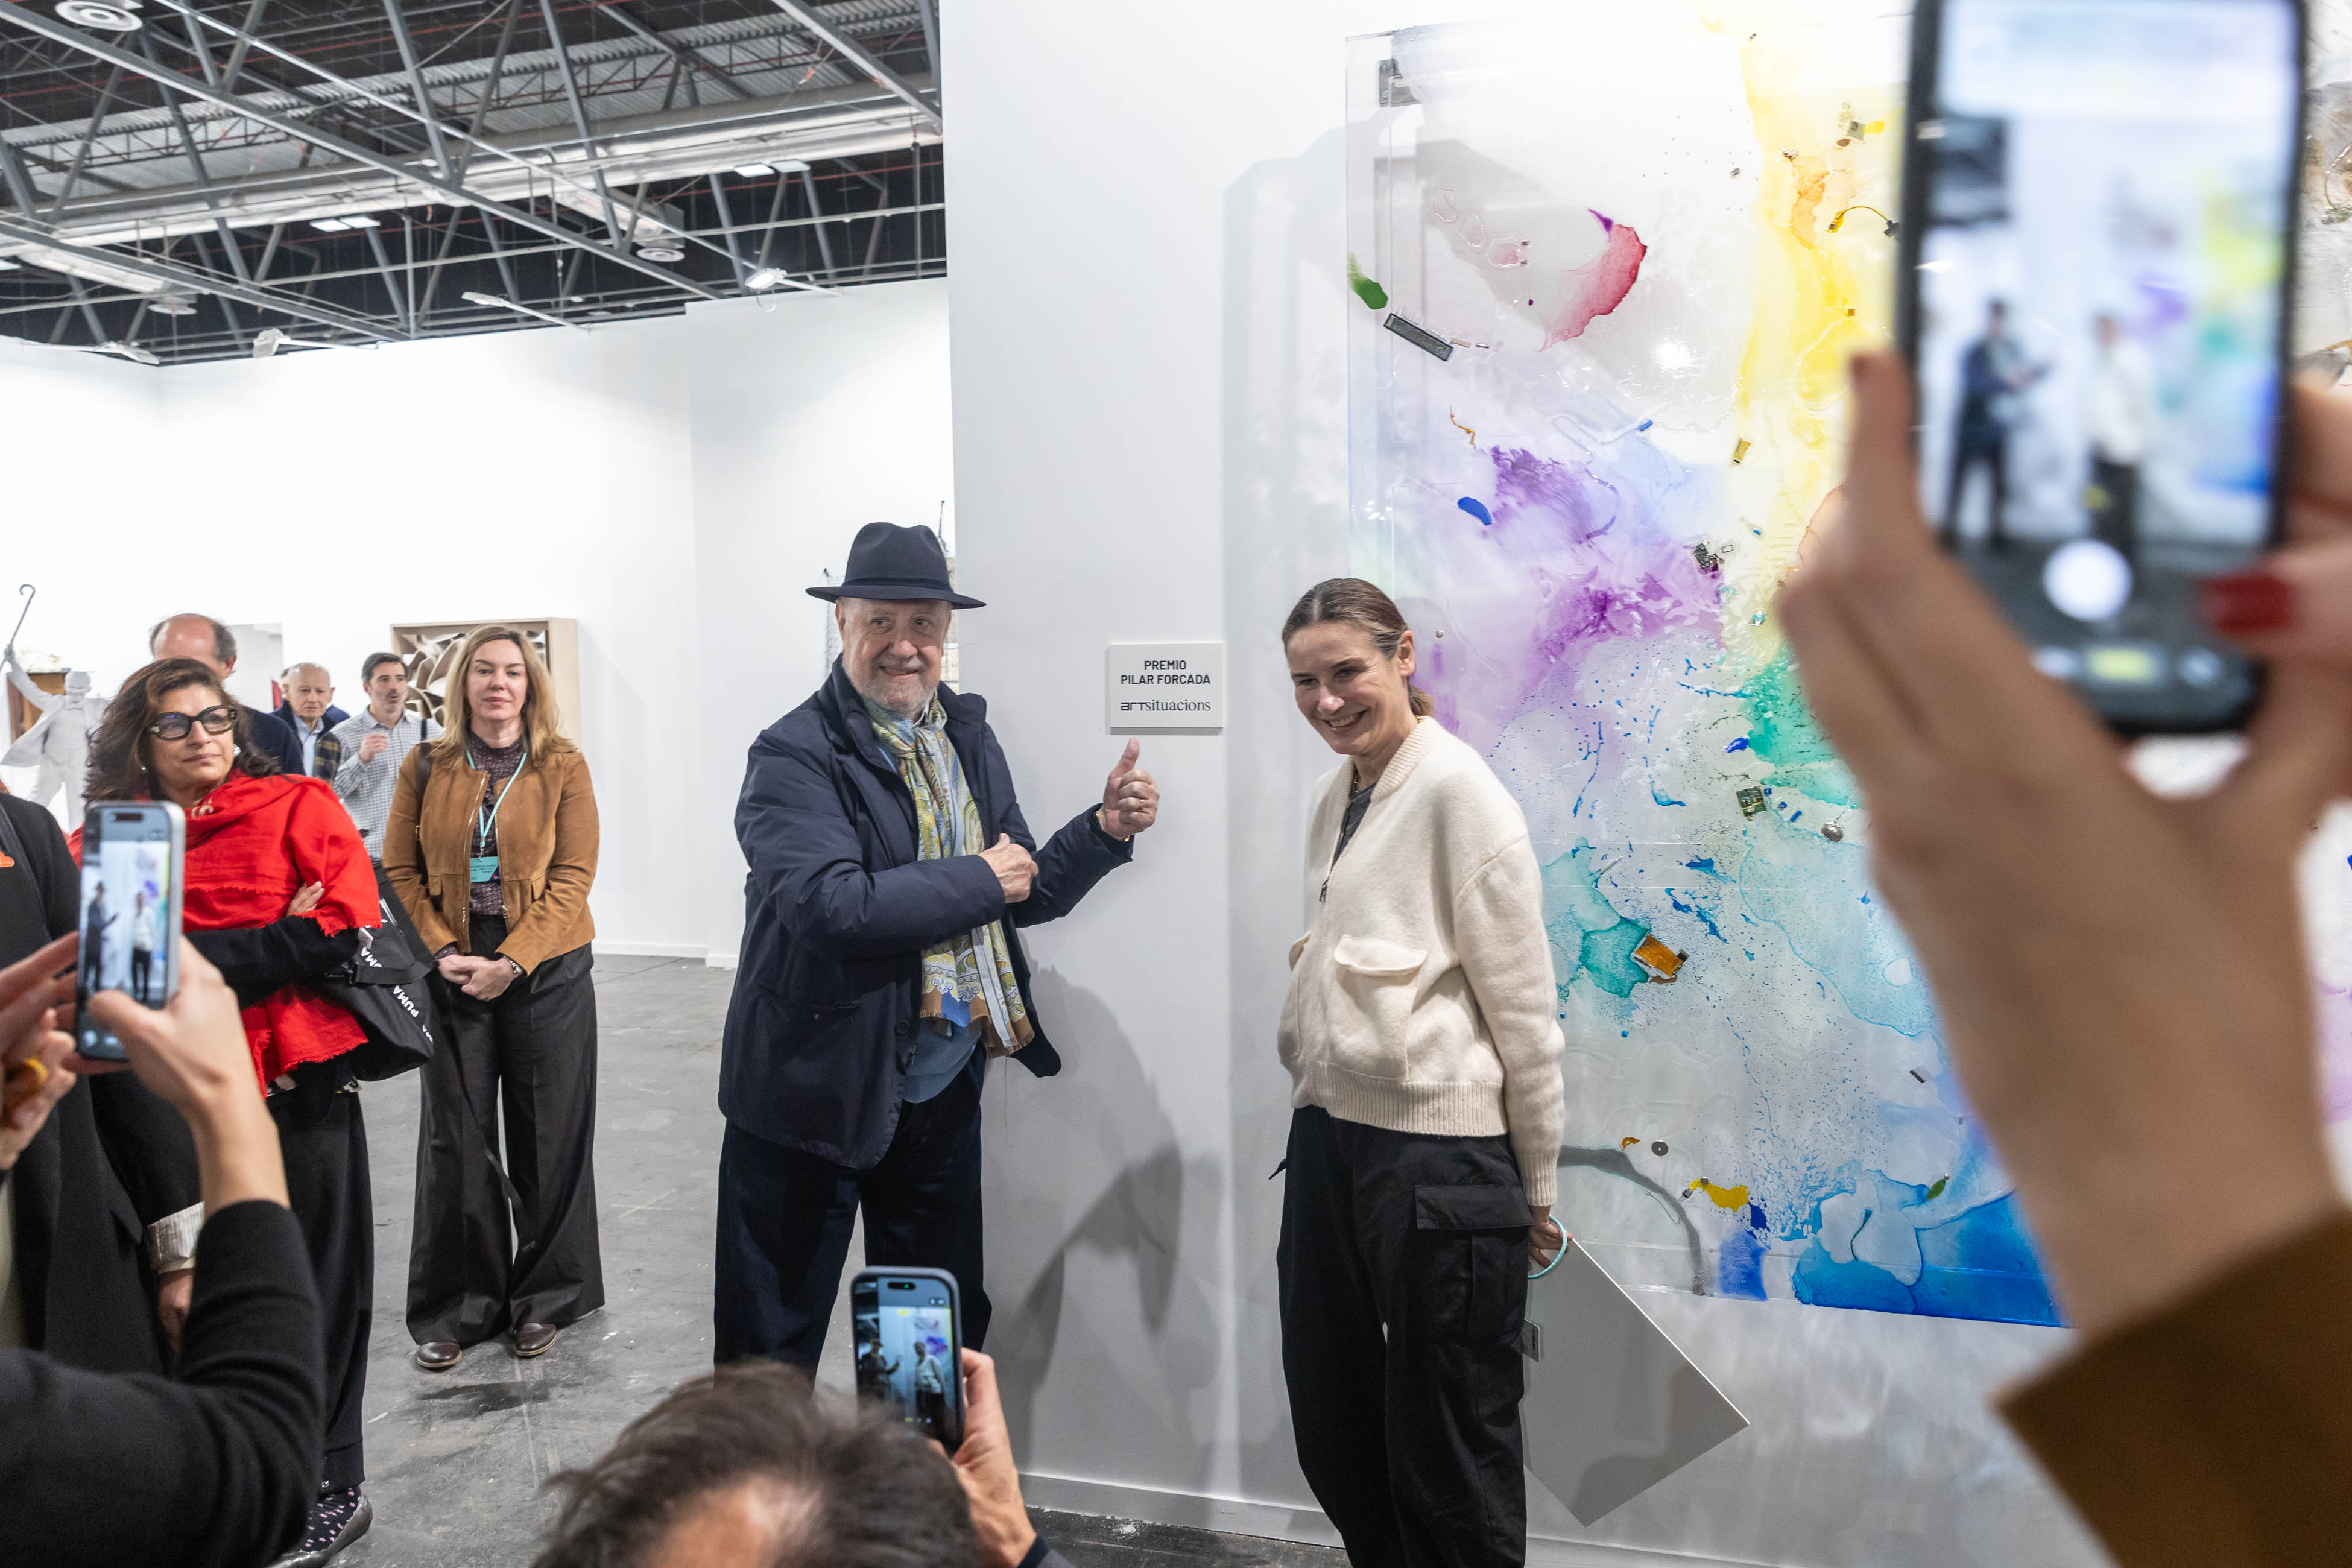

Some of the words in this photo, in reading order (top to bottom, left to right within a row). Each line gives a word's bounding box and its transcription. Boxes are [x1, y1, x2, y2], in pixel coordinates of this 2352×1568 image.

[1144, 660, 1187, 671] PREMIO
[1121, 674, 1154, 685] PILAR
[1157, 674, 1211, 685] FORCADA
[393, 985, 419, 1017] PUMA
